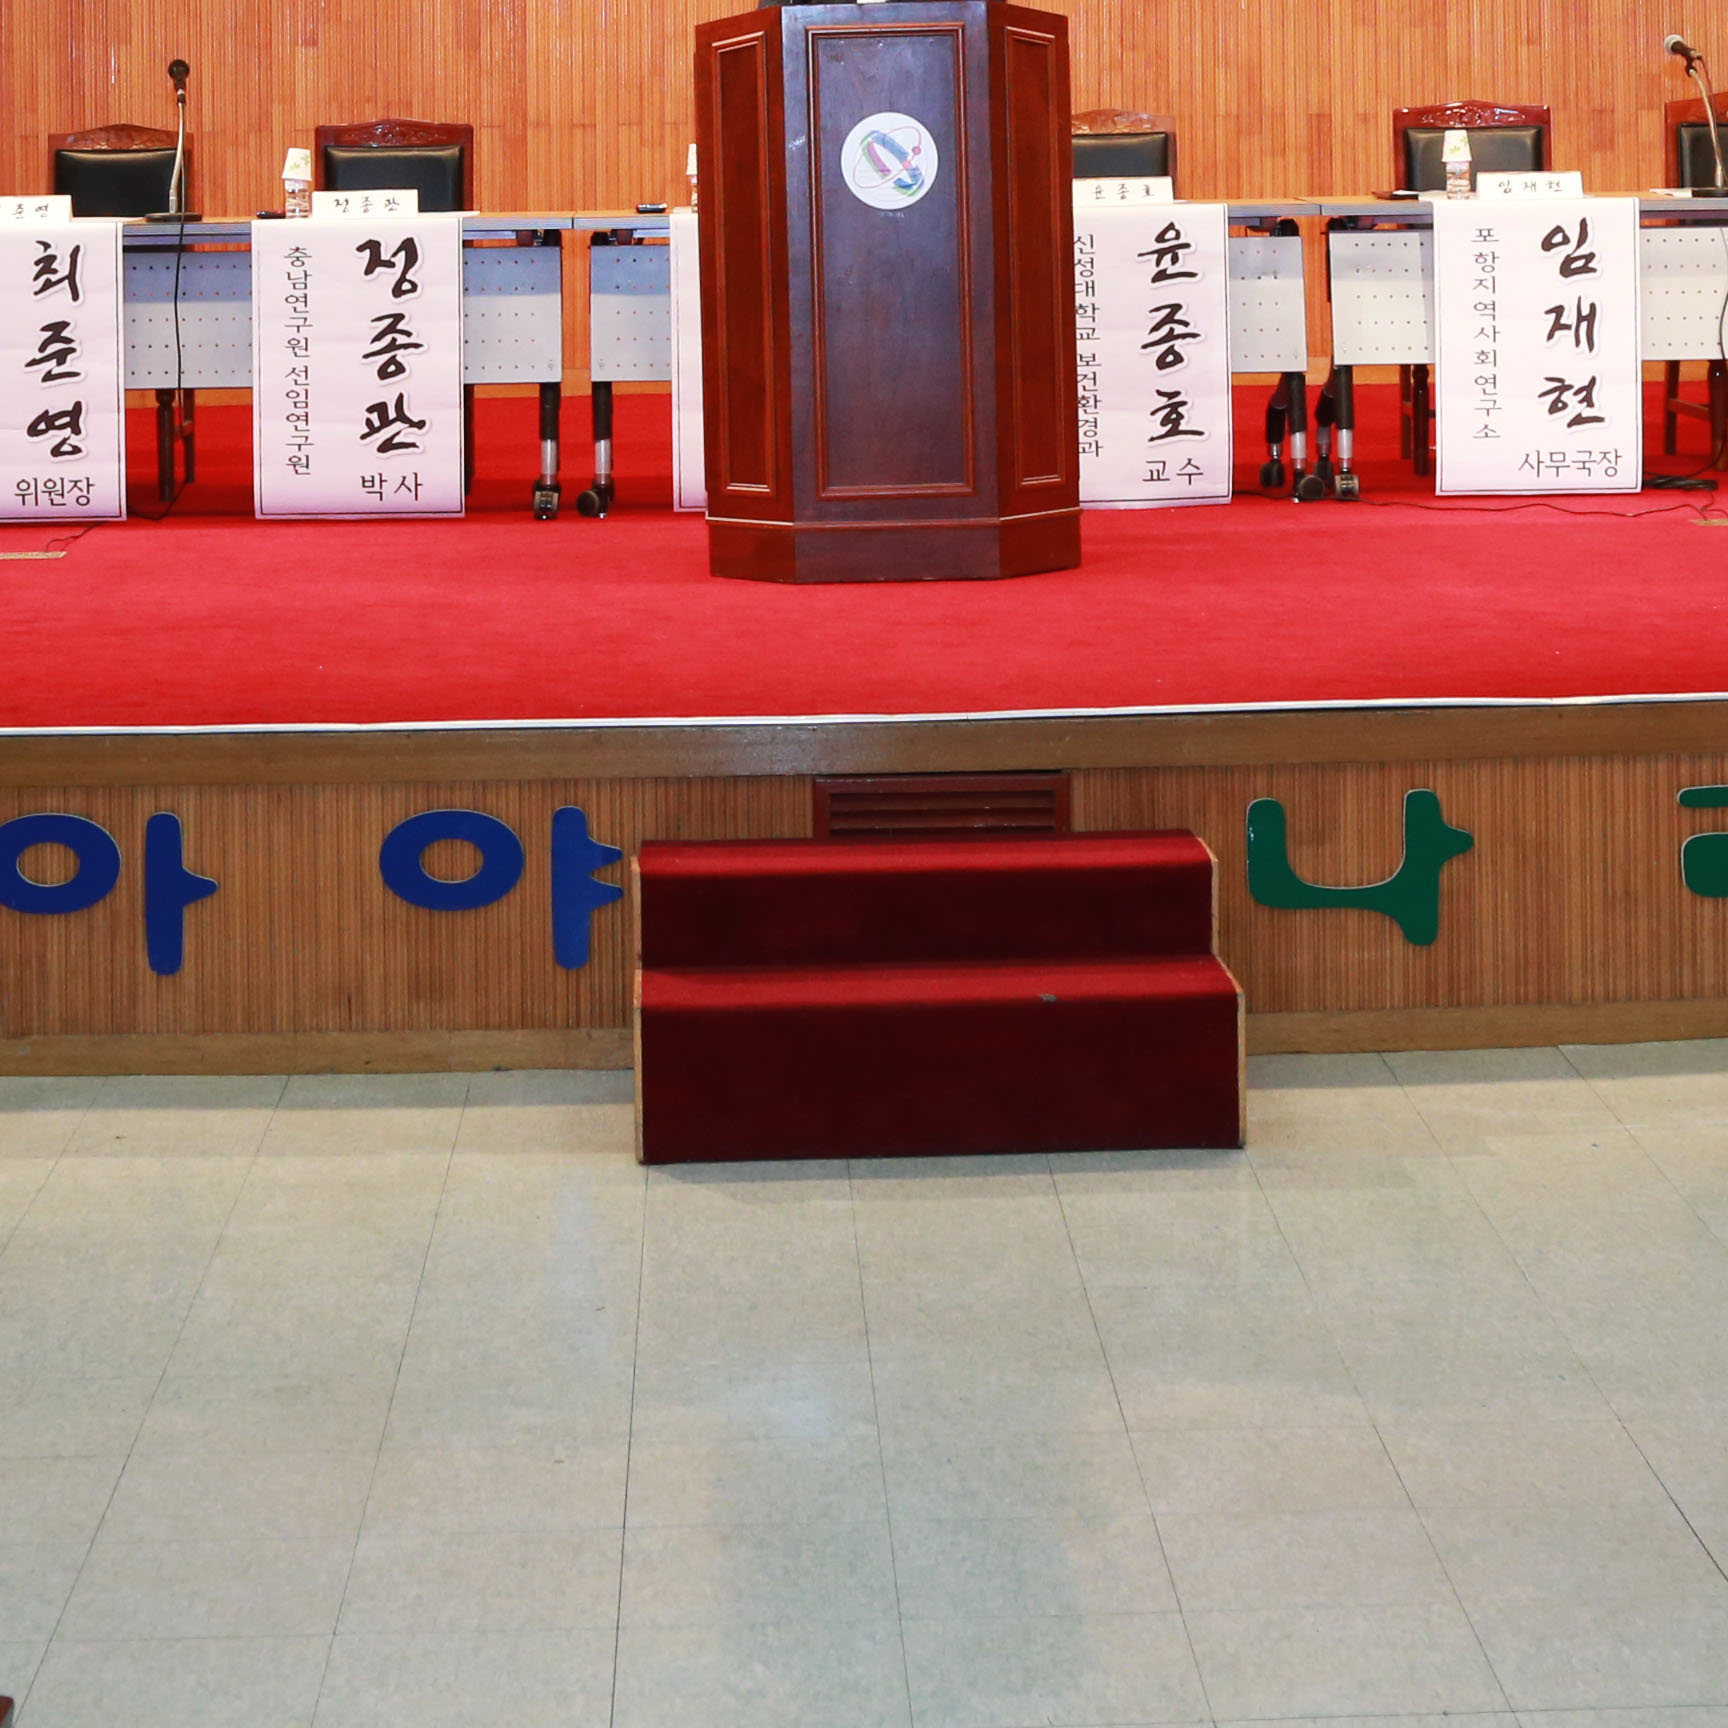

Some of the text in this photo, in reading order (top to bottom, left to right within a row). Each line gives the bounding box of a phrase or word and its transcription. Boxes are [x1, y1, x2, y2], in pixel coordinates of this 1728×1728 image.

[23, 239, 83, 458] 최준영
[284, 246, 315, 476] 충남연구원 선임연구원
[355, 236, 427, 455] 정종관
[1074, 233, 1104, 460] 신성대학교 보건환경과
[1136, 221, 1206, 443] 윤종호
[1473, 228, 1502, 439] 포항지역사회연구소
[1537, 216, 1606, 429] 임재현
[13, 476, 96, 507] 위원장
[360, 471, 424, 502] 박사
[1142, 457, 1205, 486] 교수
[1518, 448, 1623, 478] 사무국장
